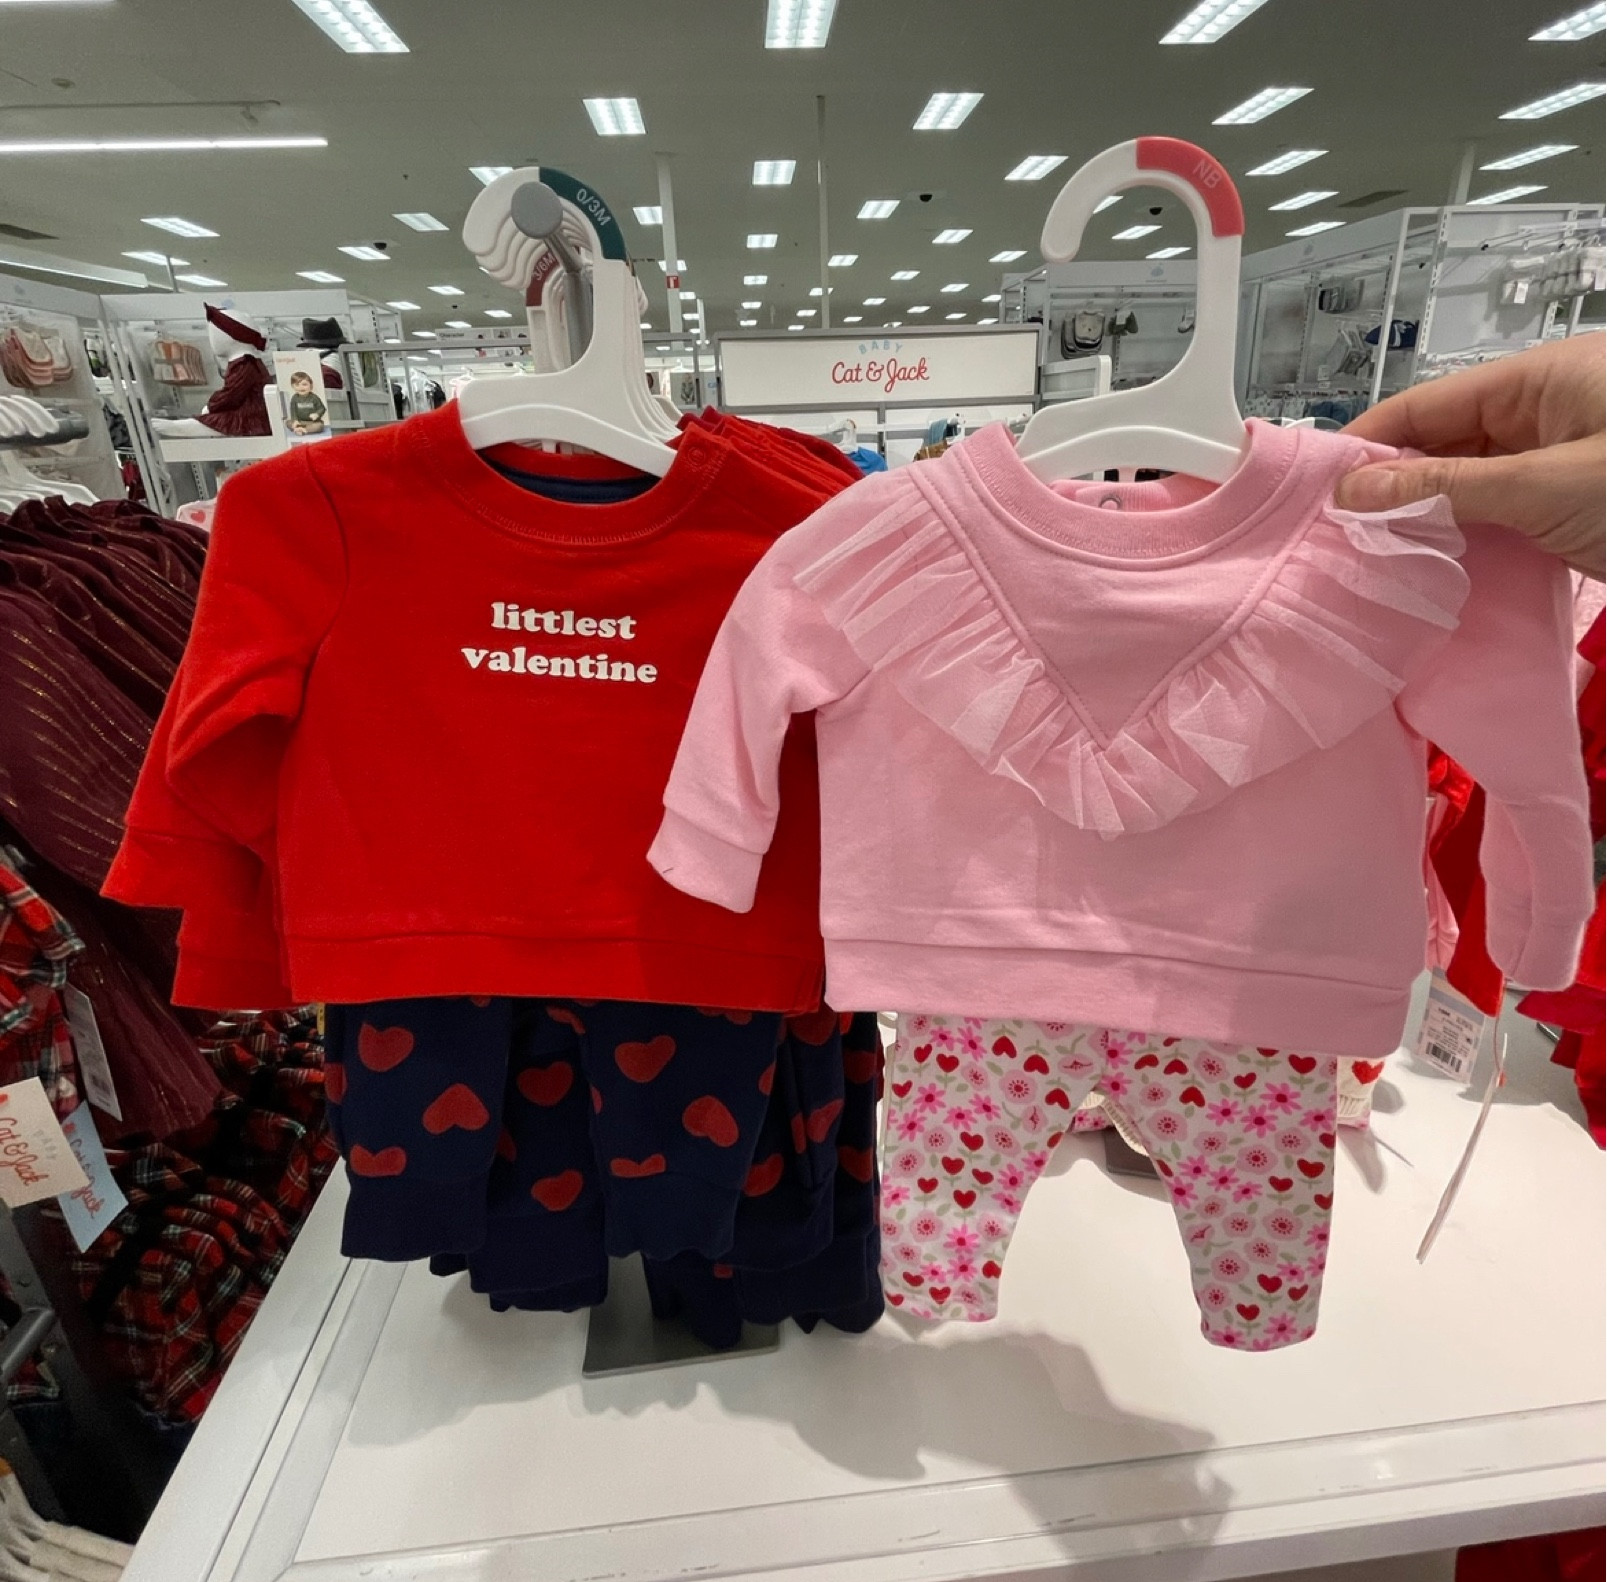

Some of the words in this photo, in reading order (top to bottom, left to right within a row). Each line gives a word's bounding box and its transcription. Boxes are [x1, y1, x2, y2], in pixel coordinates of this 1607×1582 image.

[1193, 159, 1221, 188] NB
[576, 188, 611, 226] 0/3M
[859, 340, 903, 355] BABY
[832, 361, 863, 384] Cat
[866, 361, 884, 382] &
[885, 357, 930, 393] Jack
[491, 601, 637, 640] littlest
[460, 646, 658, 683] valentine
